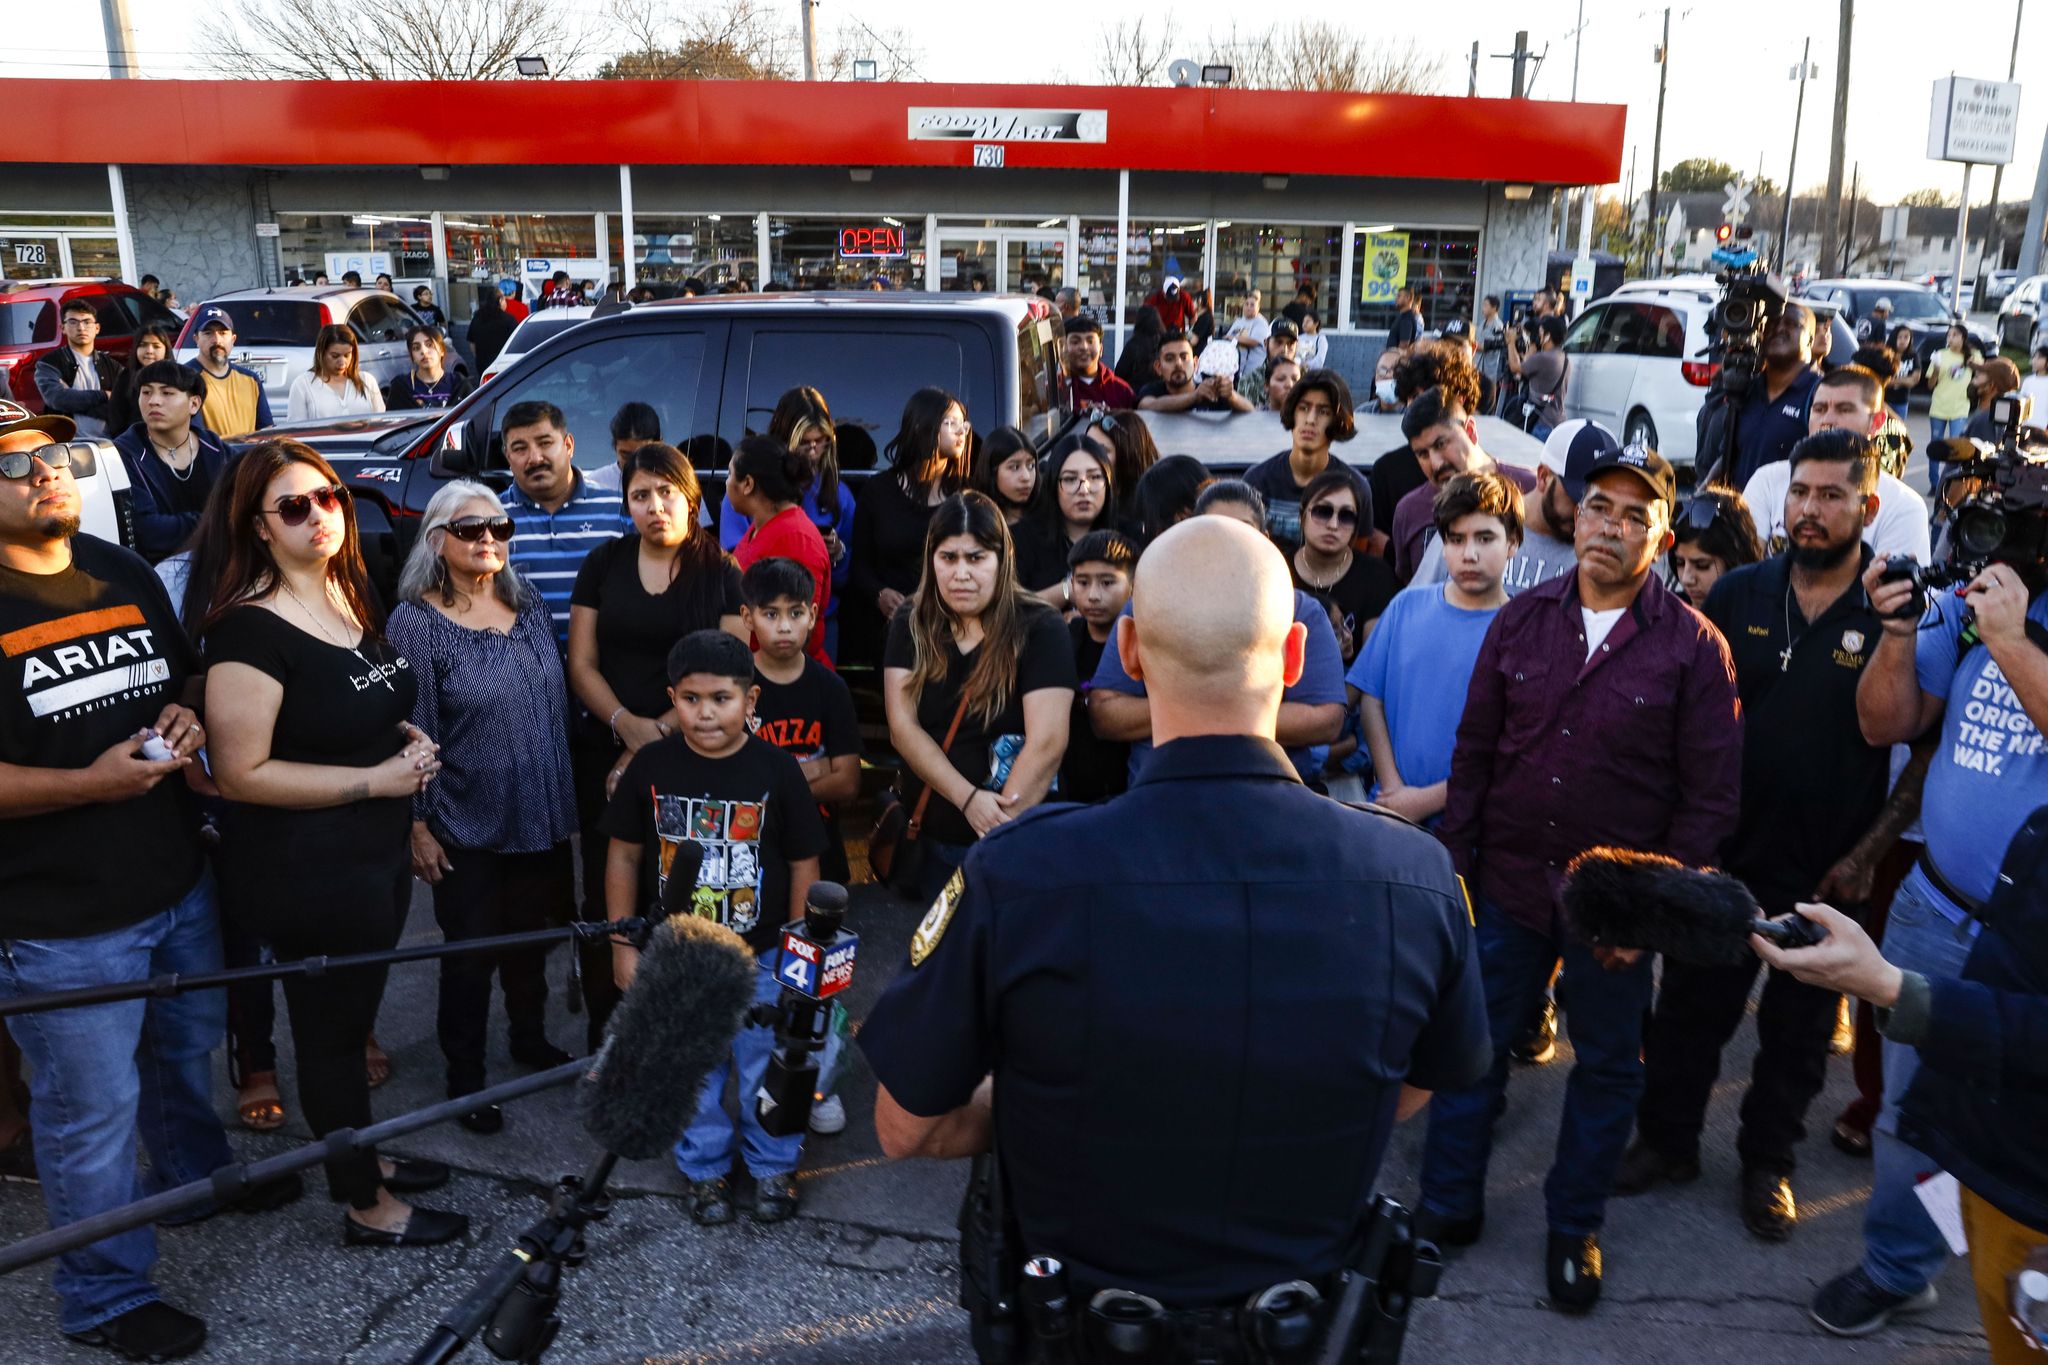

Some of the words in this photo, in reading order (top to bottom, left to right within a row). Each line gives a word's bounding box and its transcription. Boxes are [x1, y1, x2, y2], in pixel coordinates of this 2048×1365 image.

[974, 146, 1003, 166] 730
[16, 245, 45, 262] 728
[401, 251, 429, 259] EXACO
[842, 227, 902, 254] OPEN
[333, 256, 386, 275] ICE
[23, 629, 153, 690] ARIAT
[349, 657, 409, 691] bebe
[53, 697, 115, 723] PREMIUM
[123, 684, 163, 701] GOODS
[1972, 678, 2024, 711] DYN
[1959, 721, 2005, 751] THE
[1953, 743, 2004, 776] WAY.
[788, 936, 817, 962] FOX
[784, 958, 808, 989] 4
